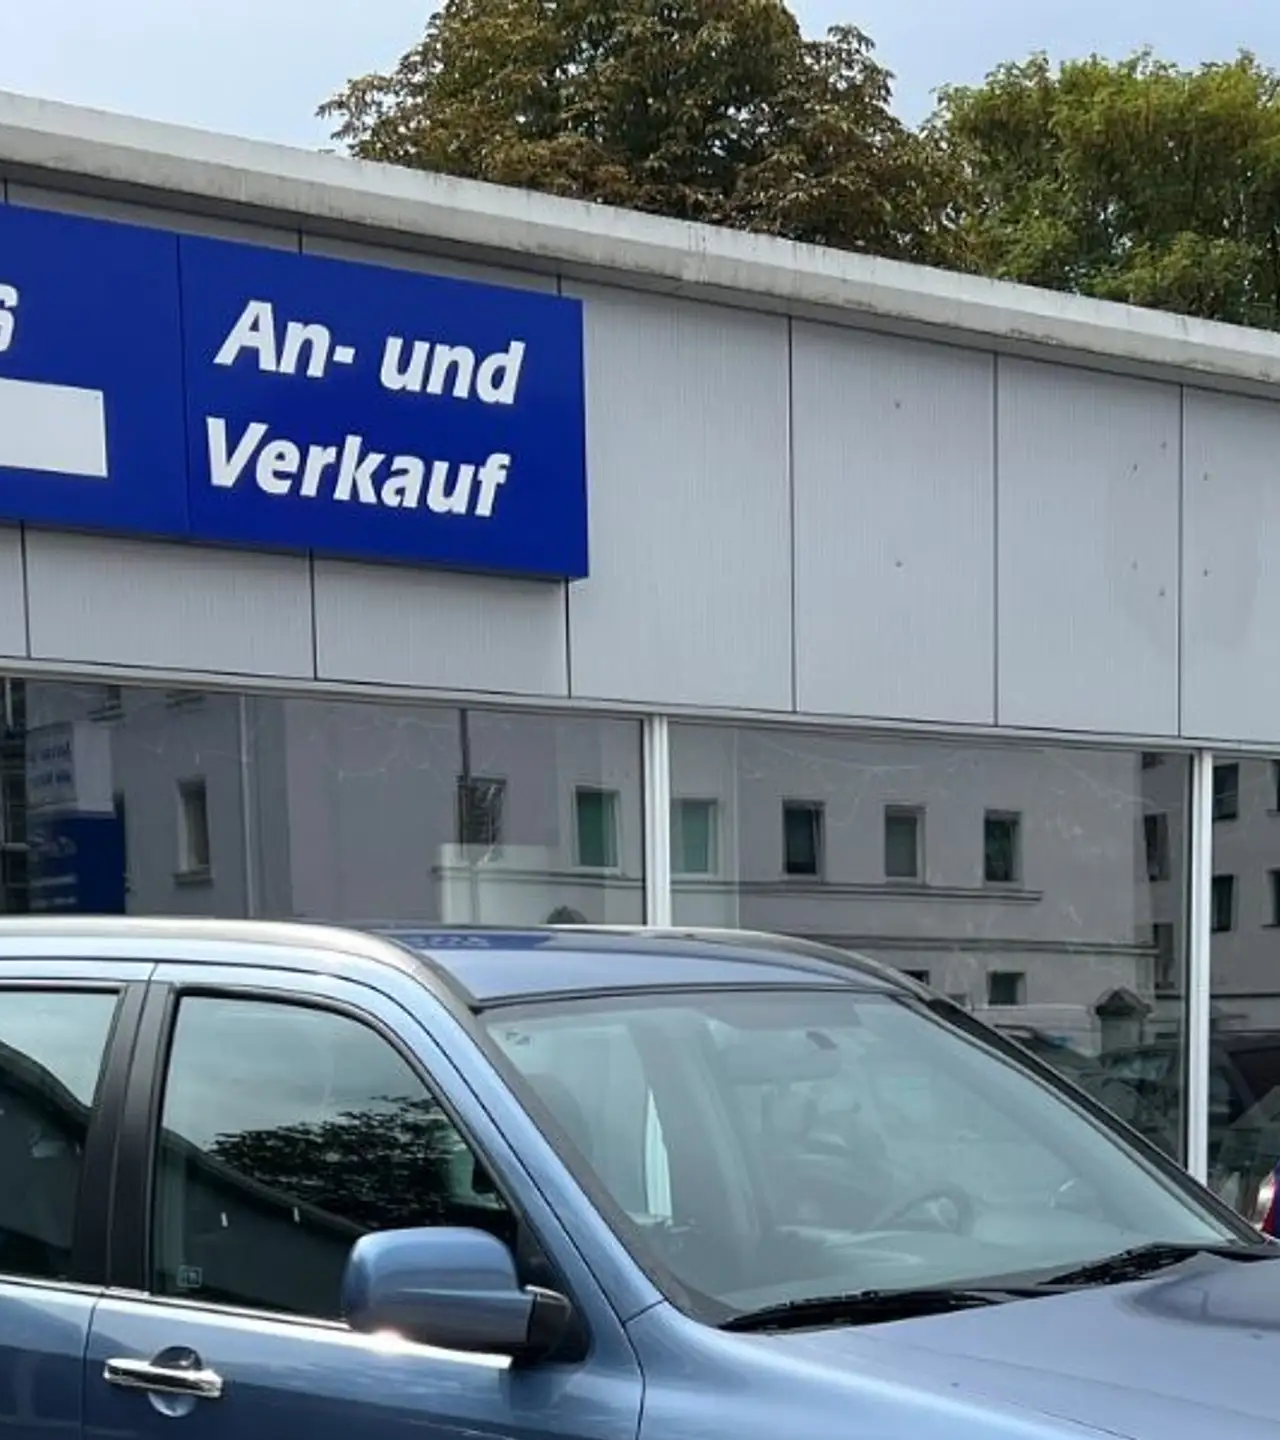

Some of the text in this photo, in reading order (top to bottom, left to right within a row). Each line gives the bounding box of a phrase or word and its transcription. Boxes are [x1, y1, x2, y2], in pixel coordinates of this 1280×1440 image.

[214, 299, 526, 405] An- und
[205, 416, 512, 518] Verkauf
